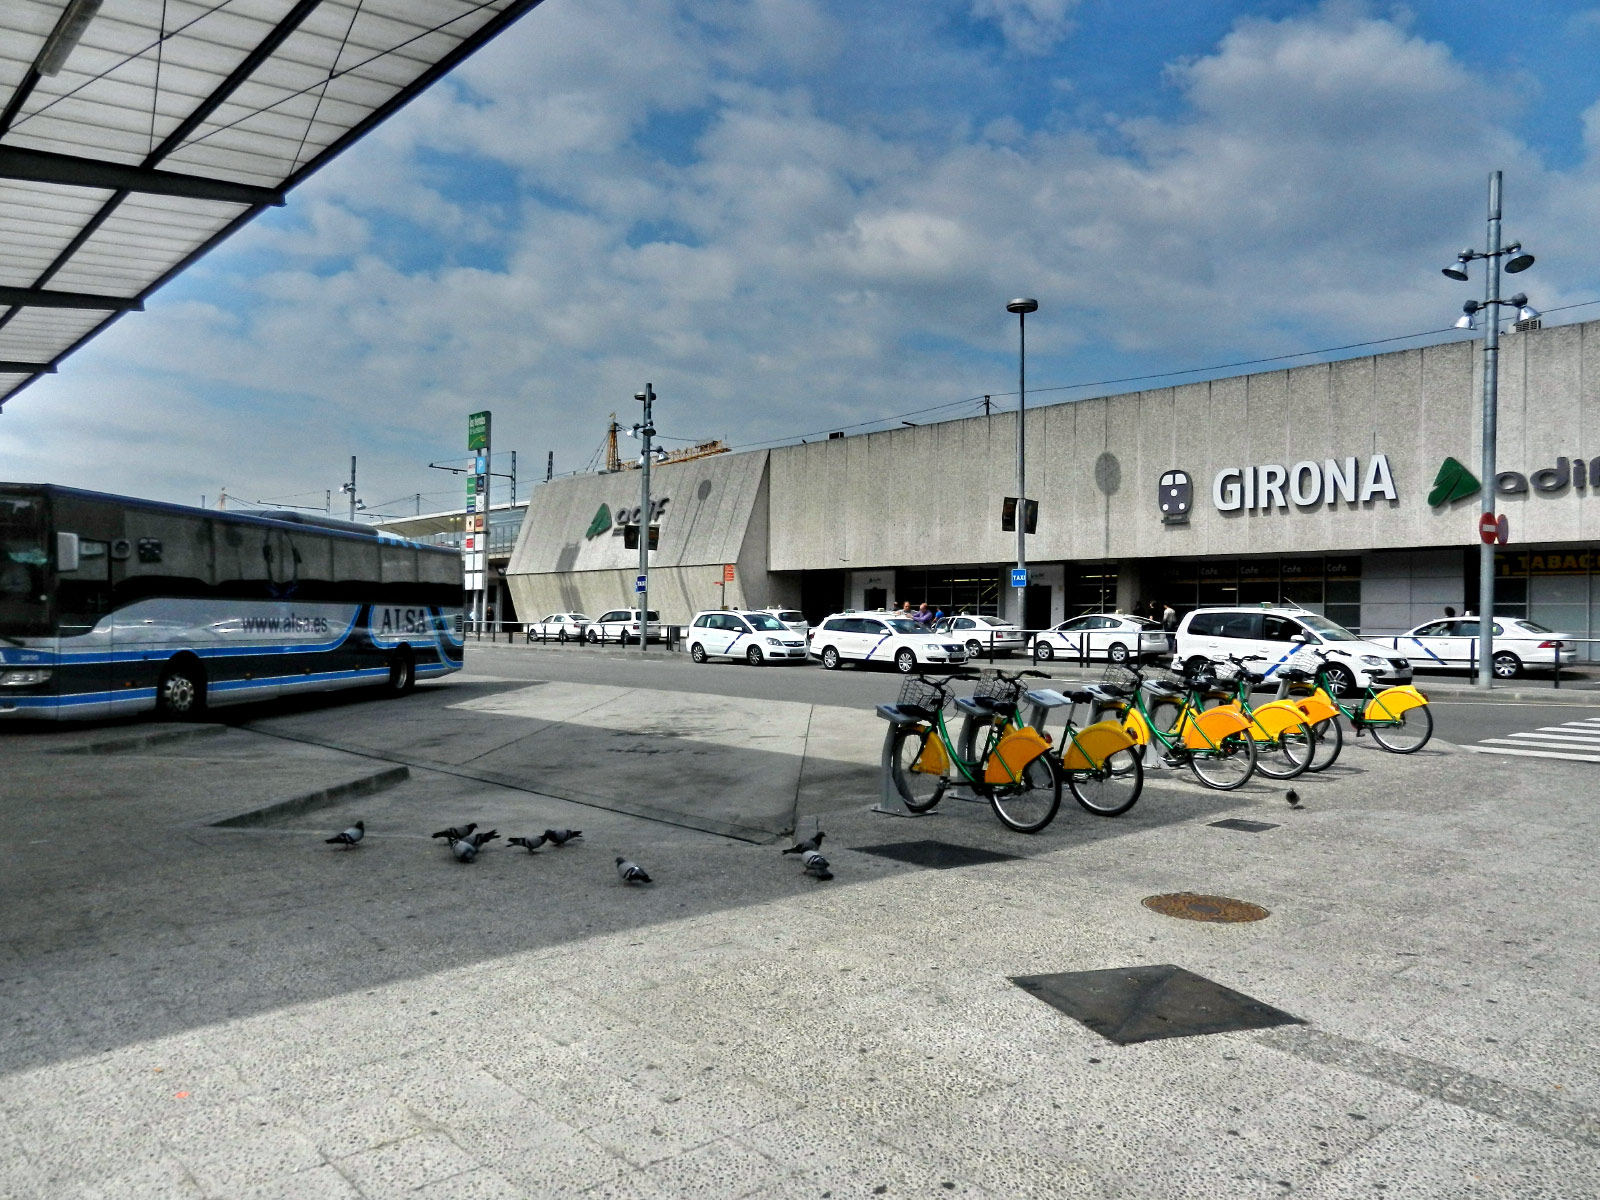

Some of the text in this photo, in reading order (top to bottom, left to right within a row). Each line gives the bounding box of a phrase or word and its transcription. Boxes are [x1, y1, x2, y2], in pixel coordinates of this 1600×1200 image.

[1212, 453, 1397, 511] GIRONA
[241, 612, 328, 634] www.alsa.es
[380, 607, 428, 634] ALSA
